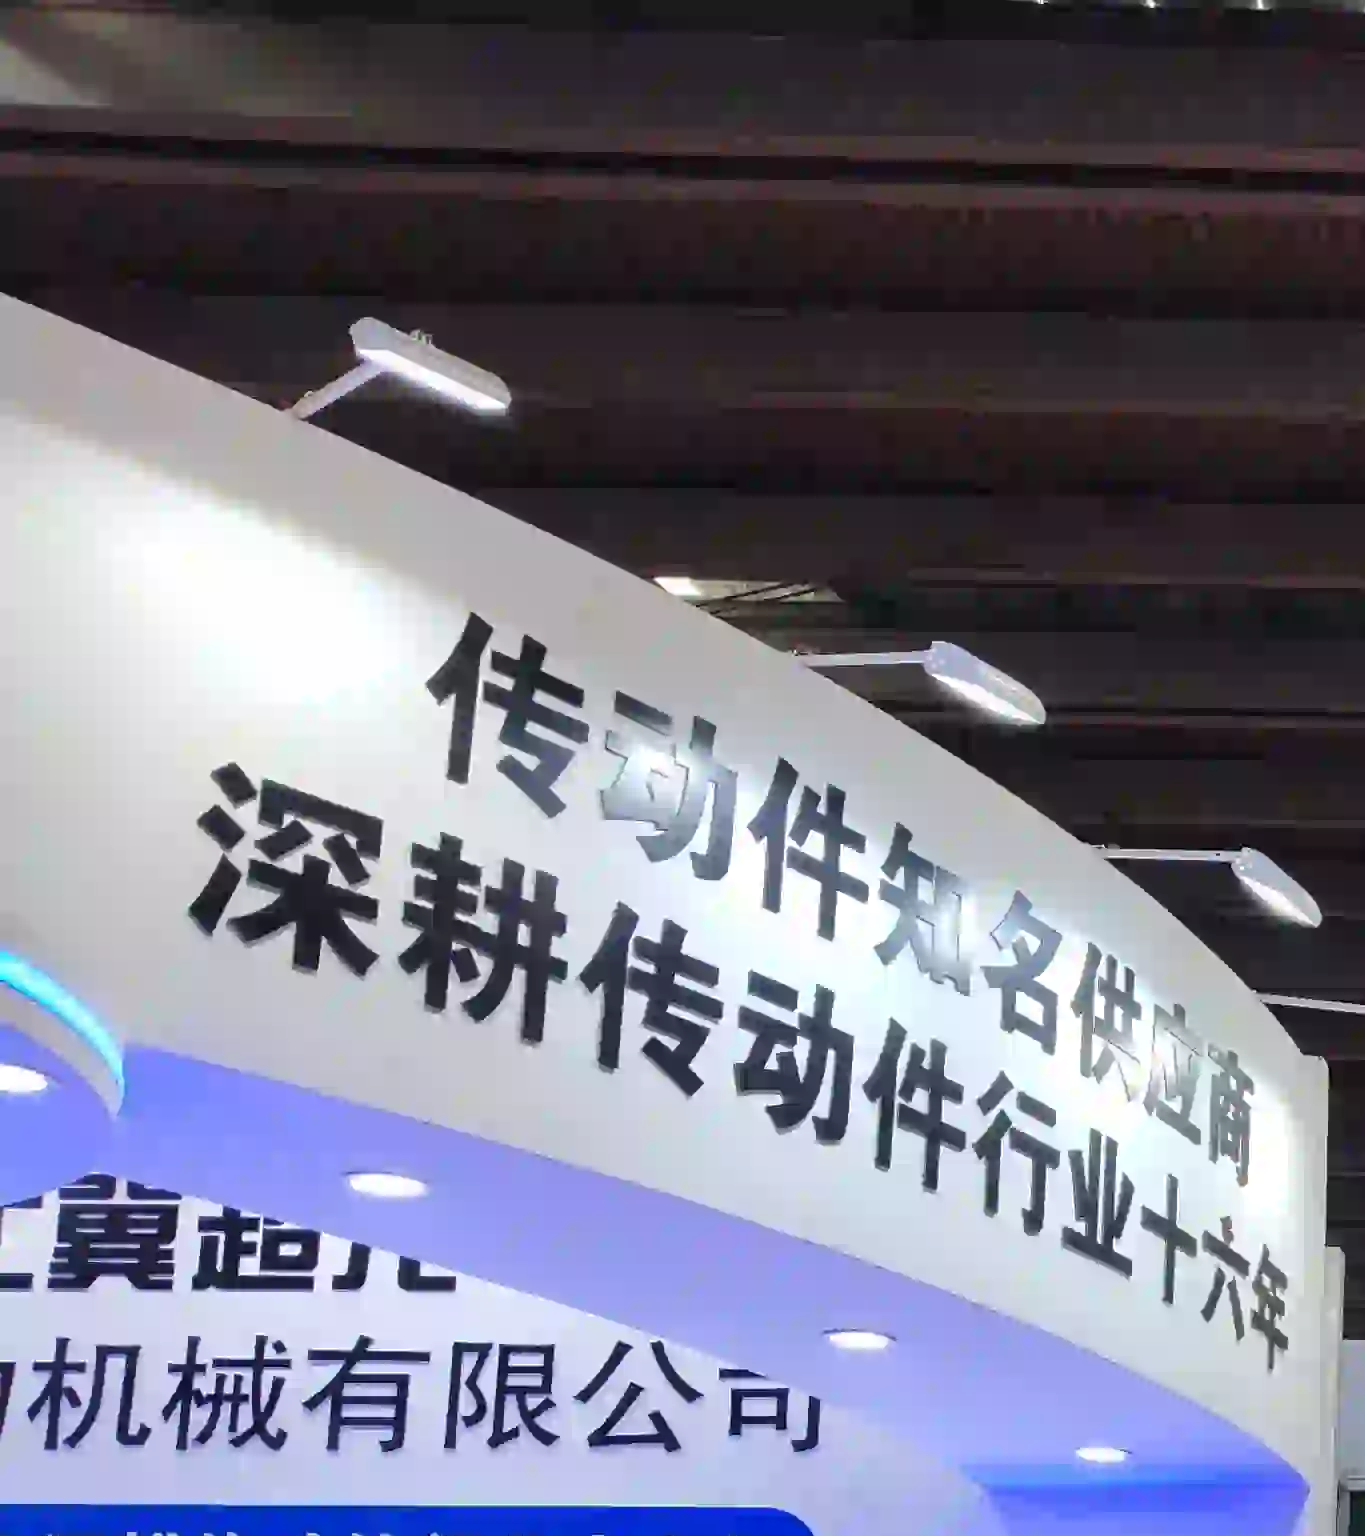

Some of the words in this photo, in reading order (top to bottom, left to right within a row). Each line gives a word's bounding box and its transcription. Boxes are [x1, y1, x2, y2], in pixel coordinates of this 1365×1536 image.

[186, 761, 1288, 1372] 深耕传动件行业十六年
[425, 611, 1254, 1187] 传动件知名供应商
[0, 1334, 823, 1453] 机械有限公司
